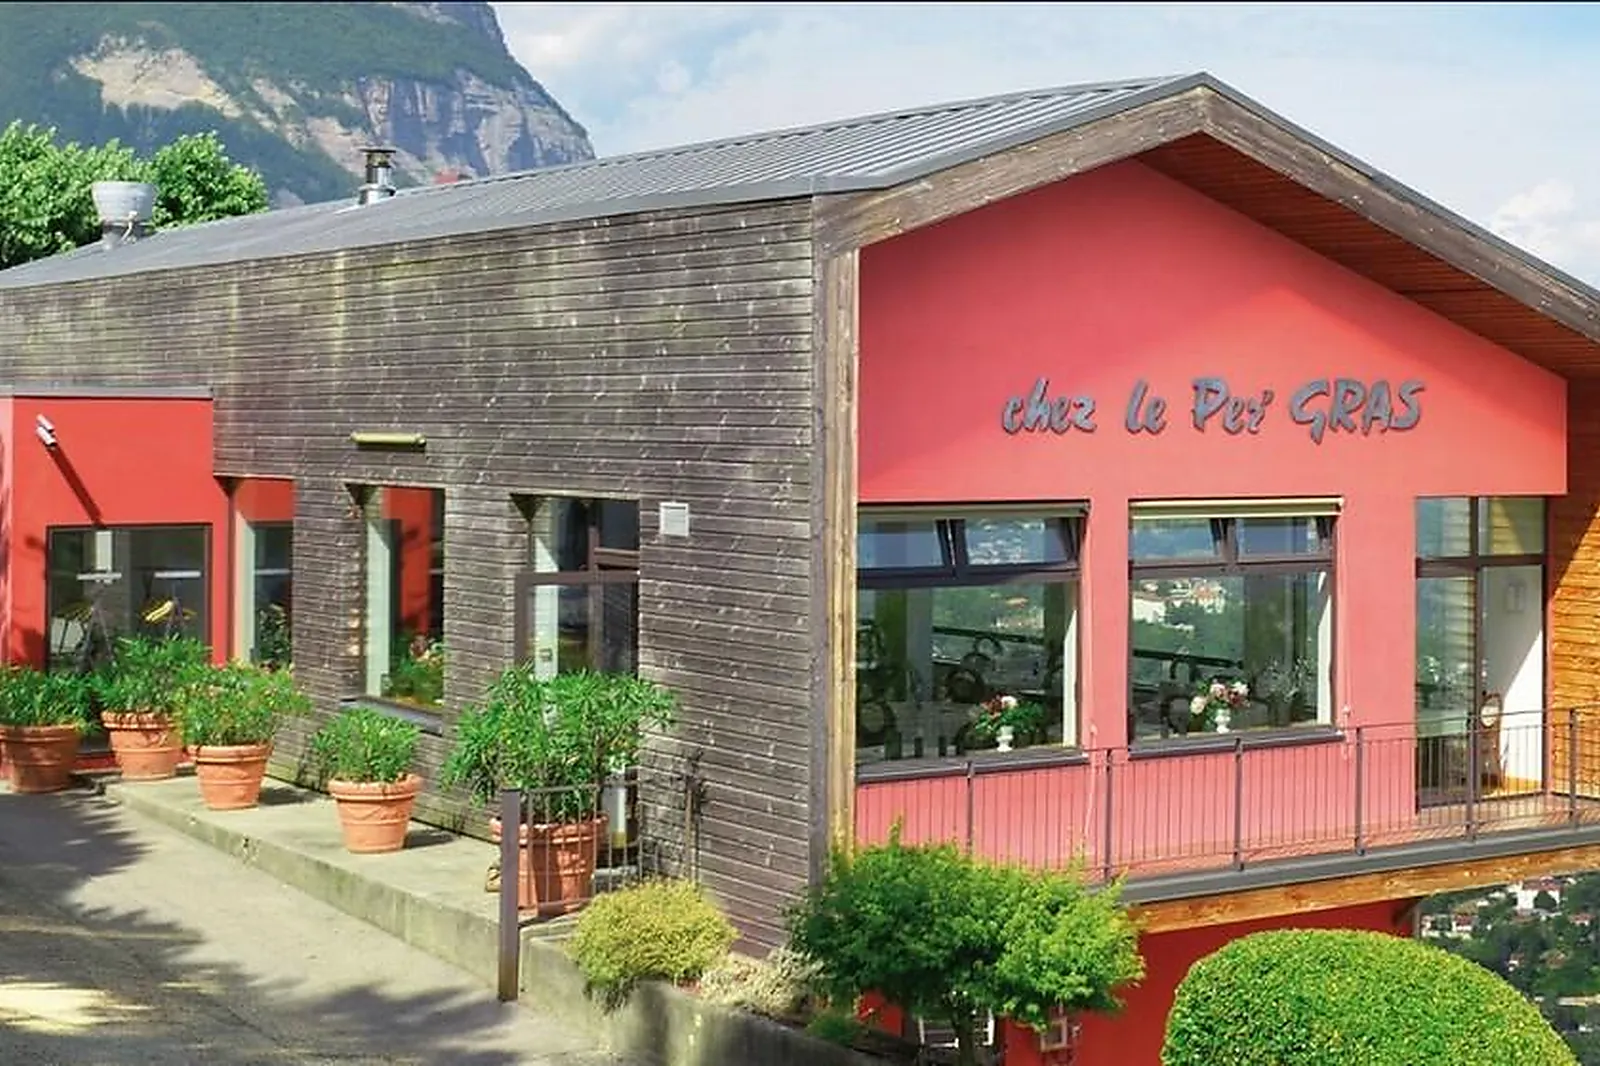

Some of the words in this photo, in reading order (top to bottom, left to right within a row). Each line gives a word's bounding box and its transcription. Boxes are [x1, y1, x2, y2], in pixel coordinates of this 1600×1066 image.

[1002, 377, 1097, 435] chez
[1125, 378, 1168, 435] le
[1289, 377, 1426, 445] GRAS
